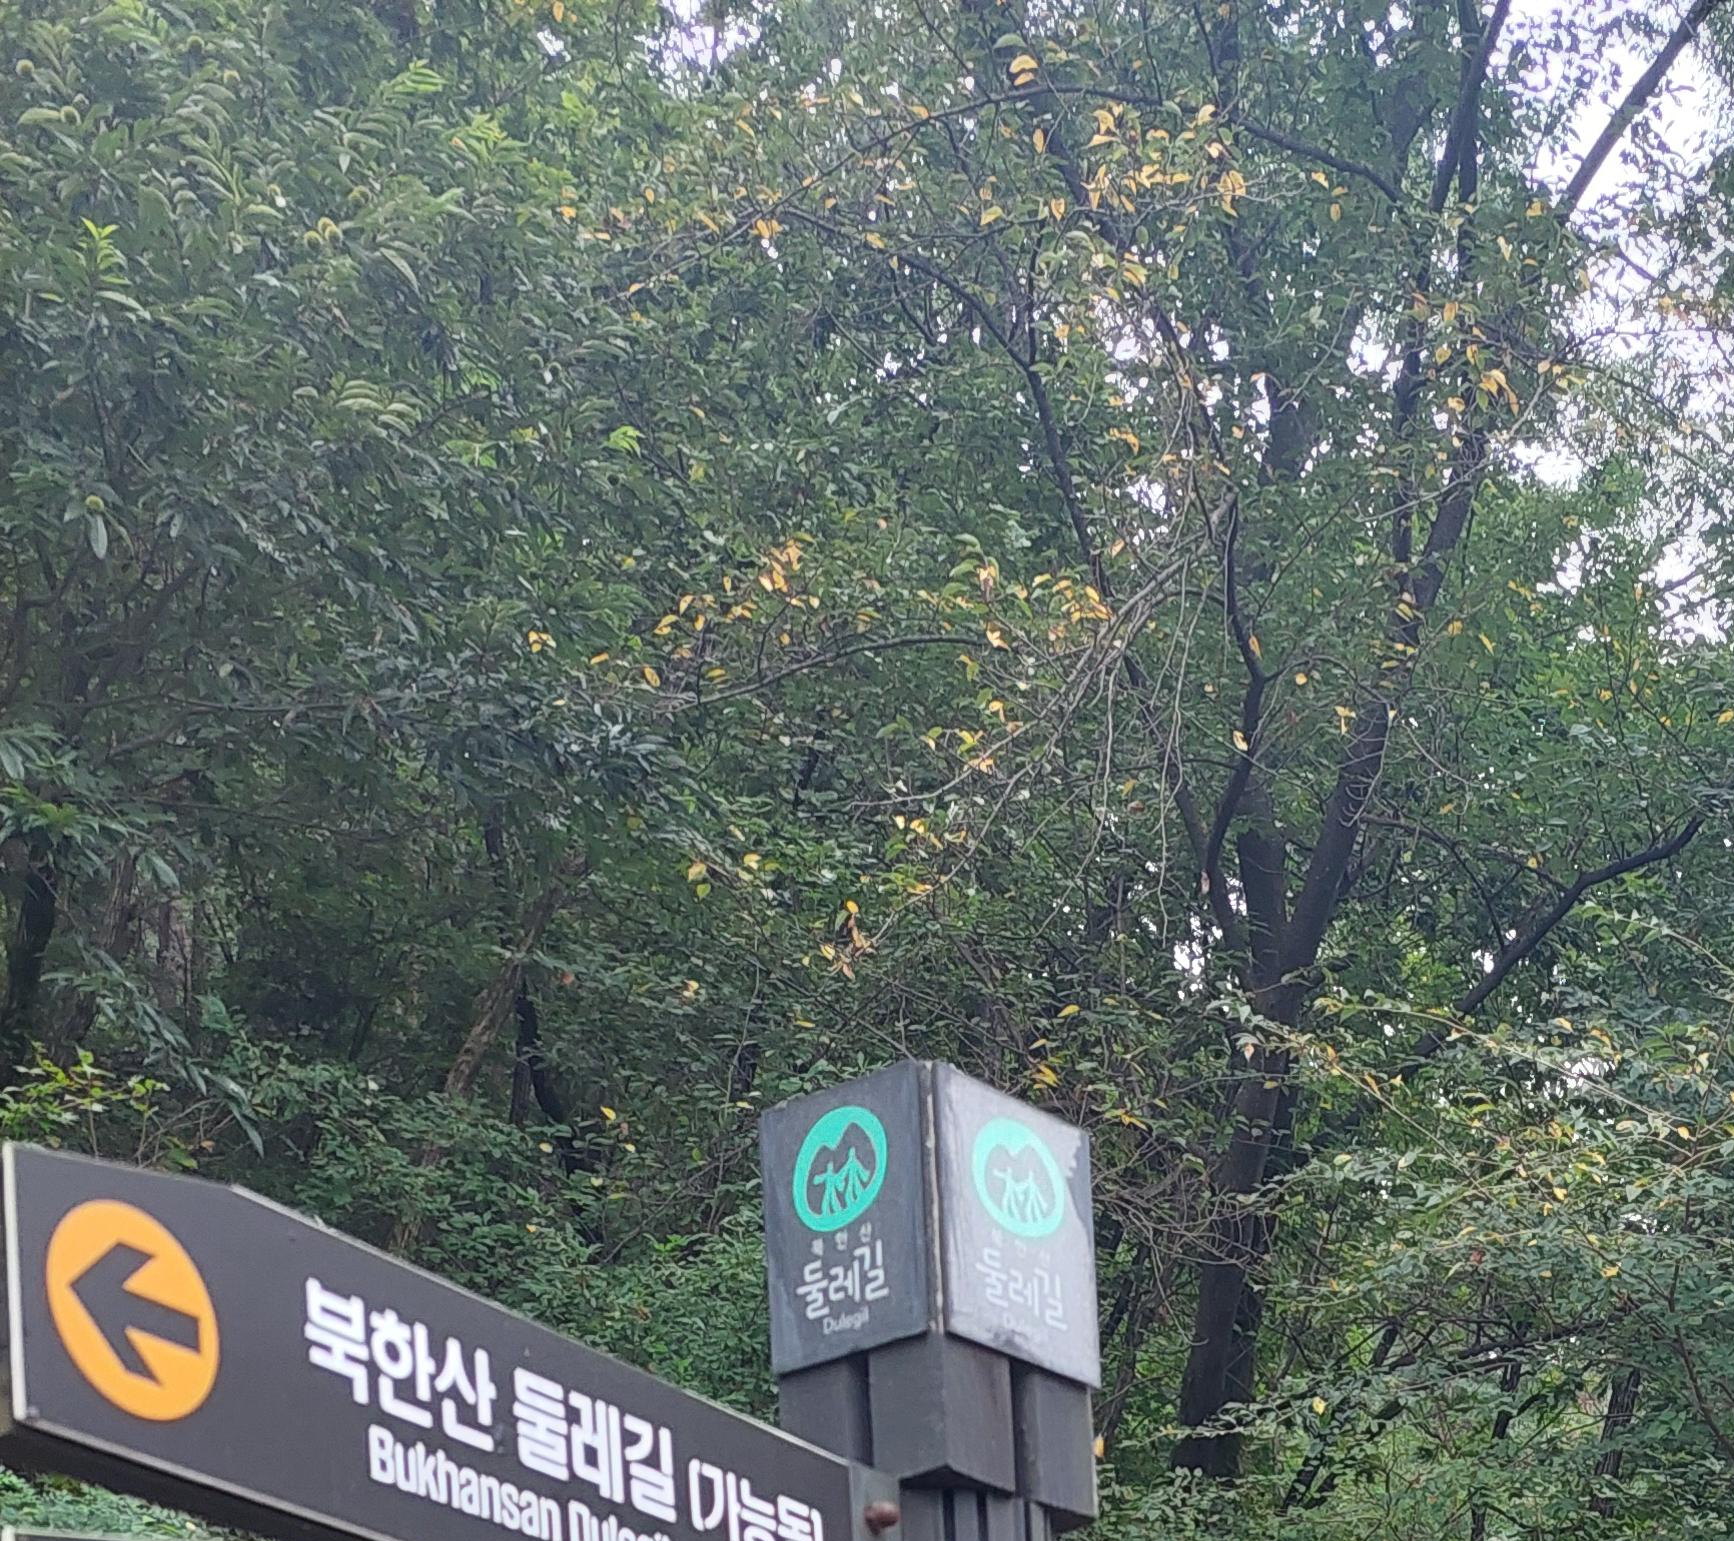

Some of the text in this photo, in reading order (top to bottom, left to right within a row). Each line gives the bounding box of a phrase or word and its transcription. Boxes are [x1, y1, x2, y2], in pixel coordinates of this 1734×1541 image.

[796, 1239, 890, 1320] 둘레길
[975, 1247, 1069, 1331] 둘레길
[304, 1277, 497, 1452] 북한산
[512, 1367, 677, 1524] 둘레길
